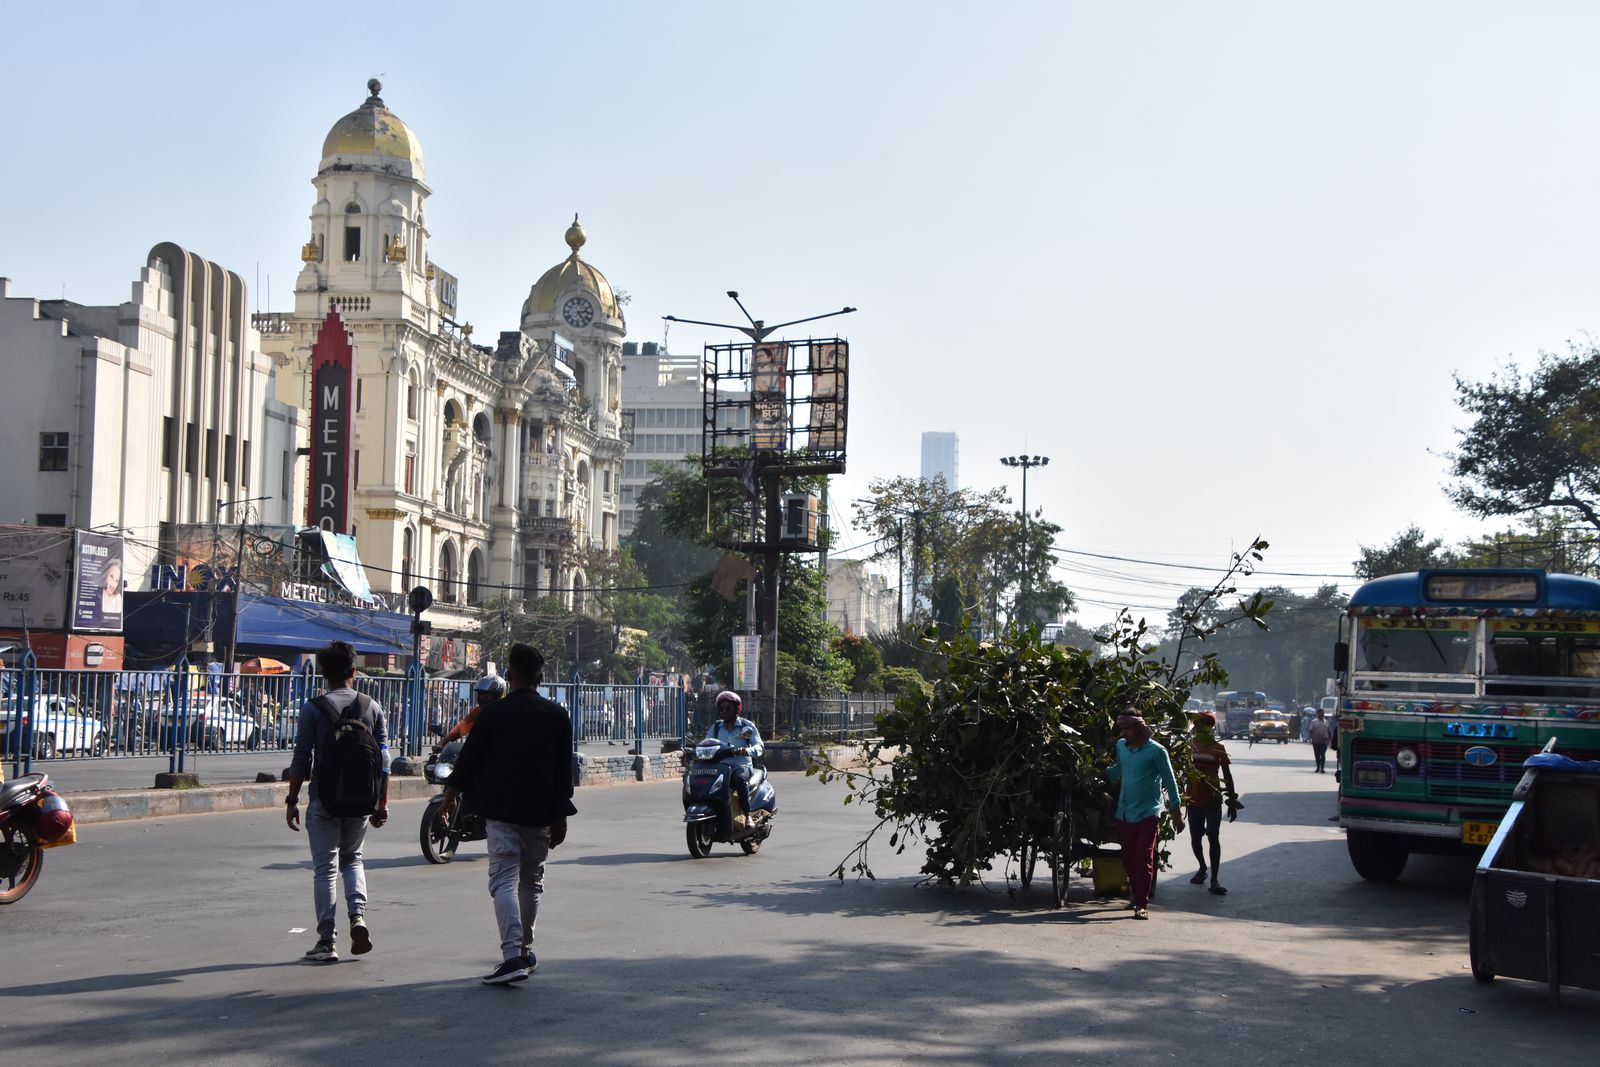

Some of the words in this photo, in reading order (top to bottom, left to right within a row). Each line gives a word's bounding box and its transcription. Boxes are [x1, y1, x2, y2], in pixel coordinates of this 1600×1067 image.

[441, 278, 456, 308] LIC
[319, 386, 339, 531] METRO
[151, 564, 238, 590] INOX
[3, 592, 30, 602] Rs.45
[281, 582, 327, 603] METRO
[1382, 619, 1452, 629] JDB
[1510, 621, 1586, 632] JDB
[1450, 723, 1511, 737] TATA
